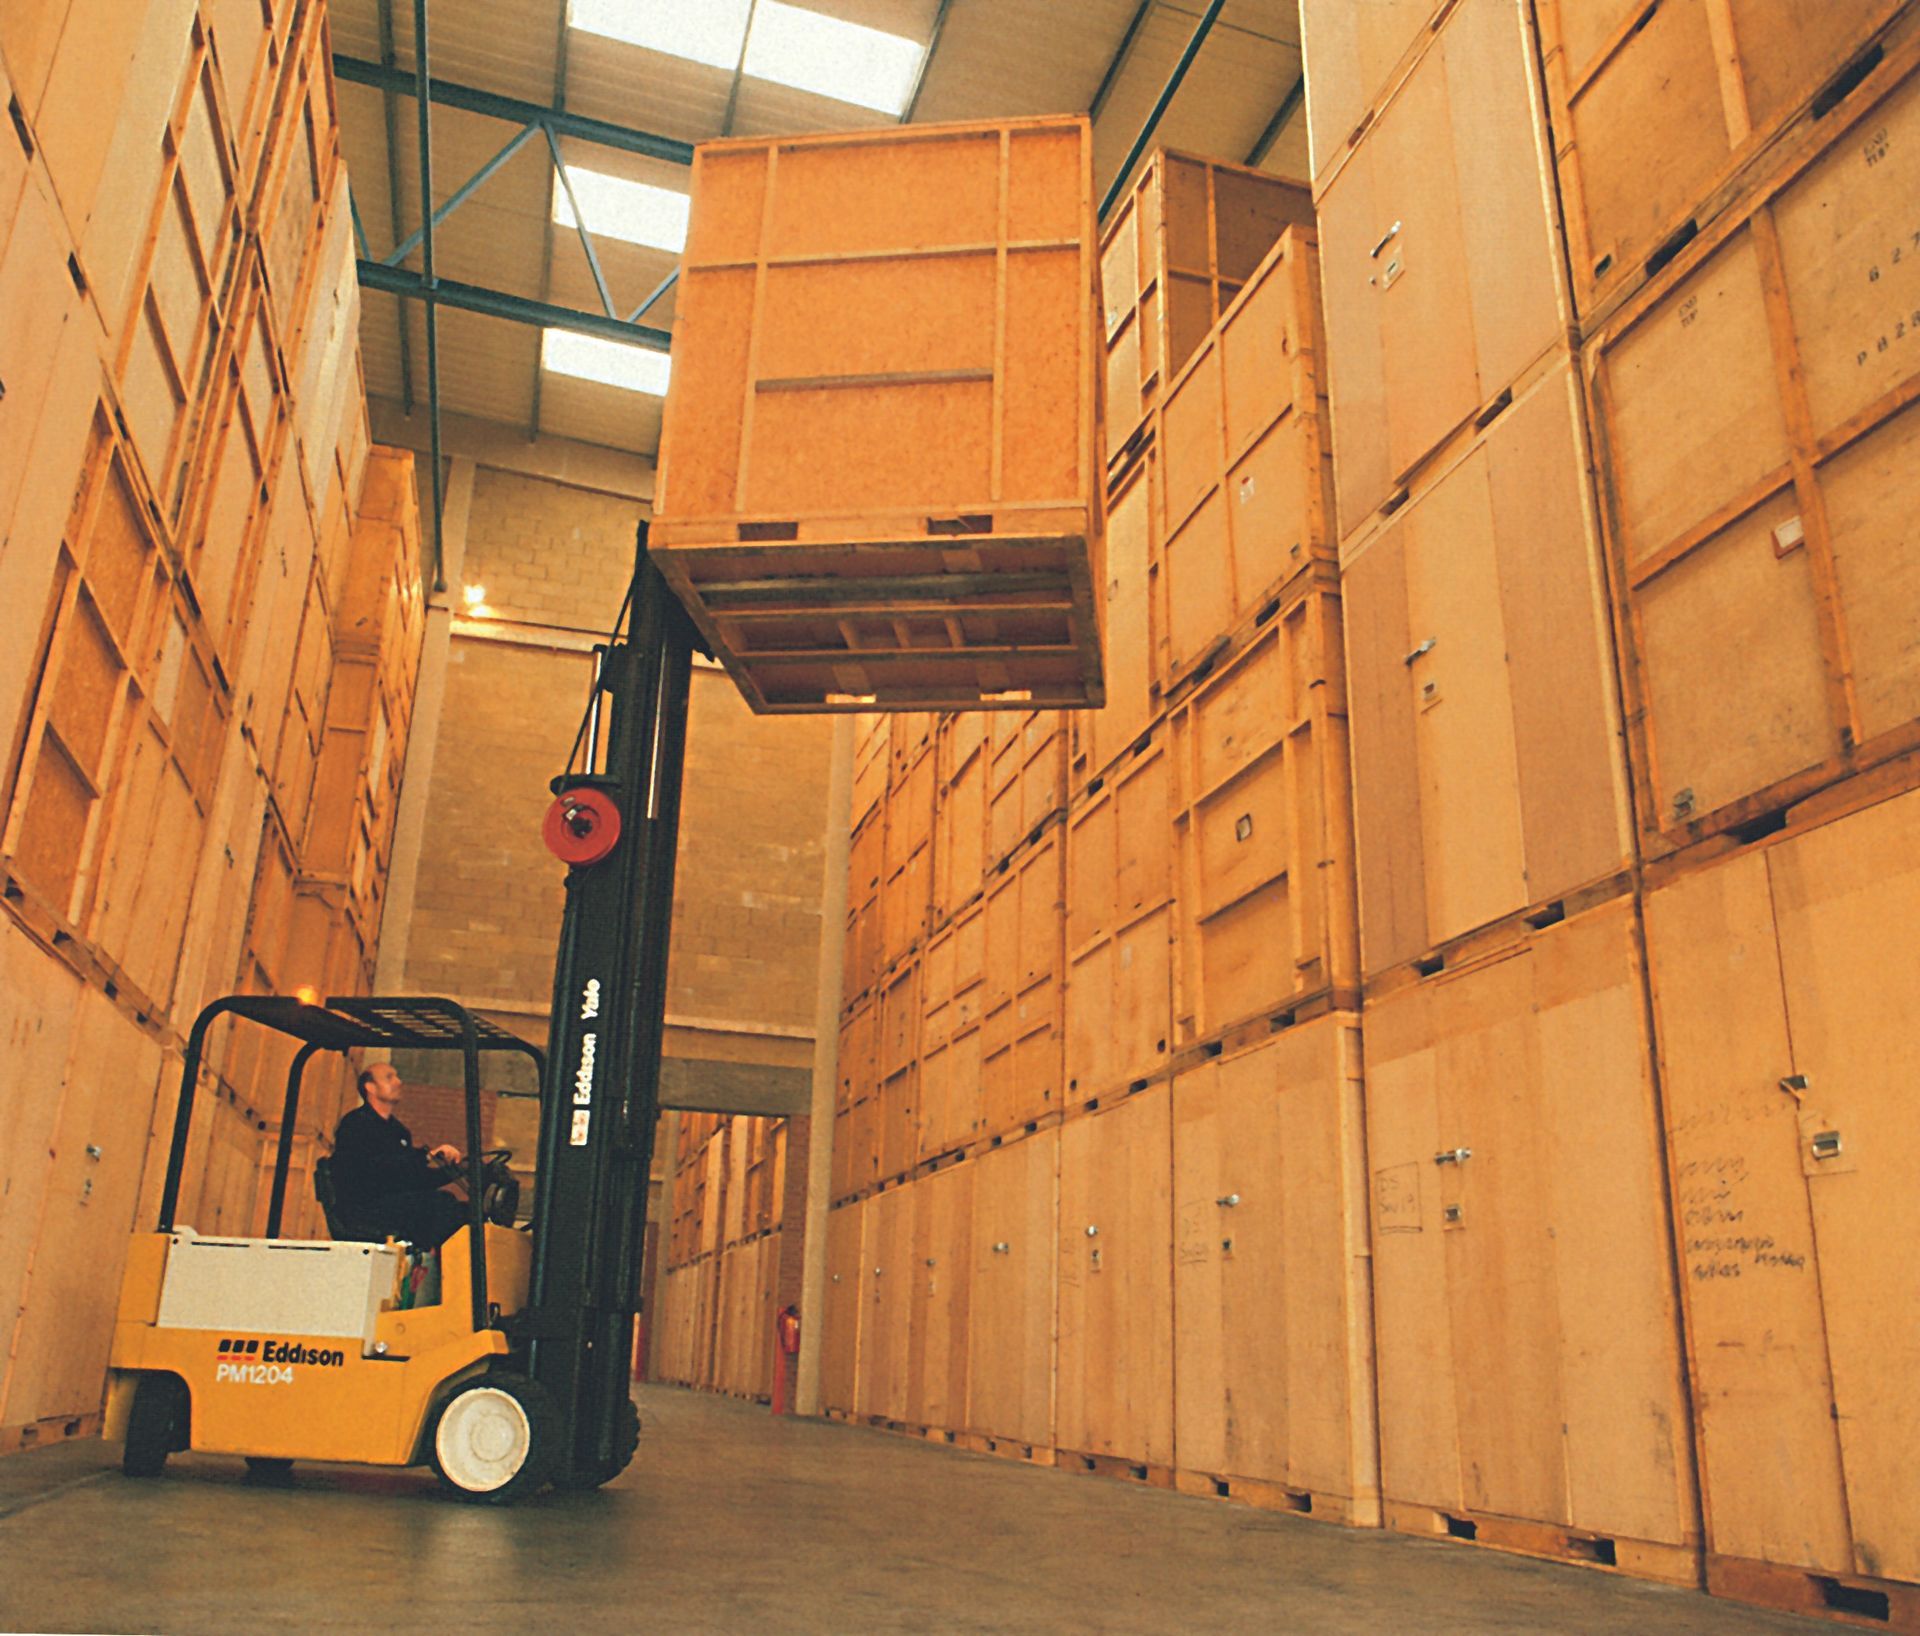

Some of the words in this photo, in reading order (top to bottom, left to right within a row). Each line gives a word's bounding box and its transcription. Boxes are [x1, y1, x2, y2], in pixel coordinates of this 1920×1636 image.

[580, 978, 601, 1020] Yale
[573, 1032, 597, 1105] Eddison
[262, 1340, 344, 1367] Eddison
[216, 1363, 294, 1384] PM1204
